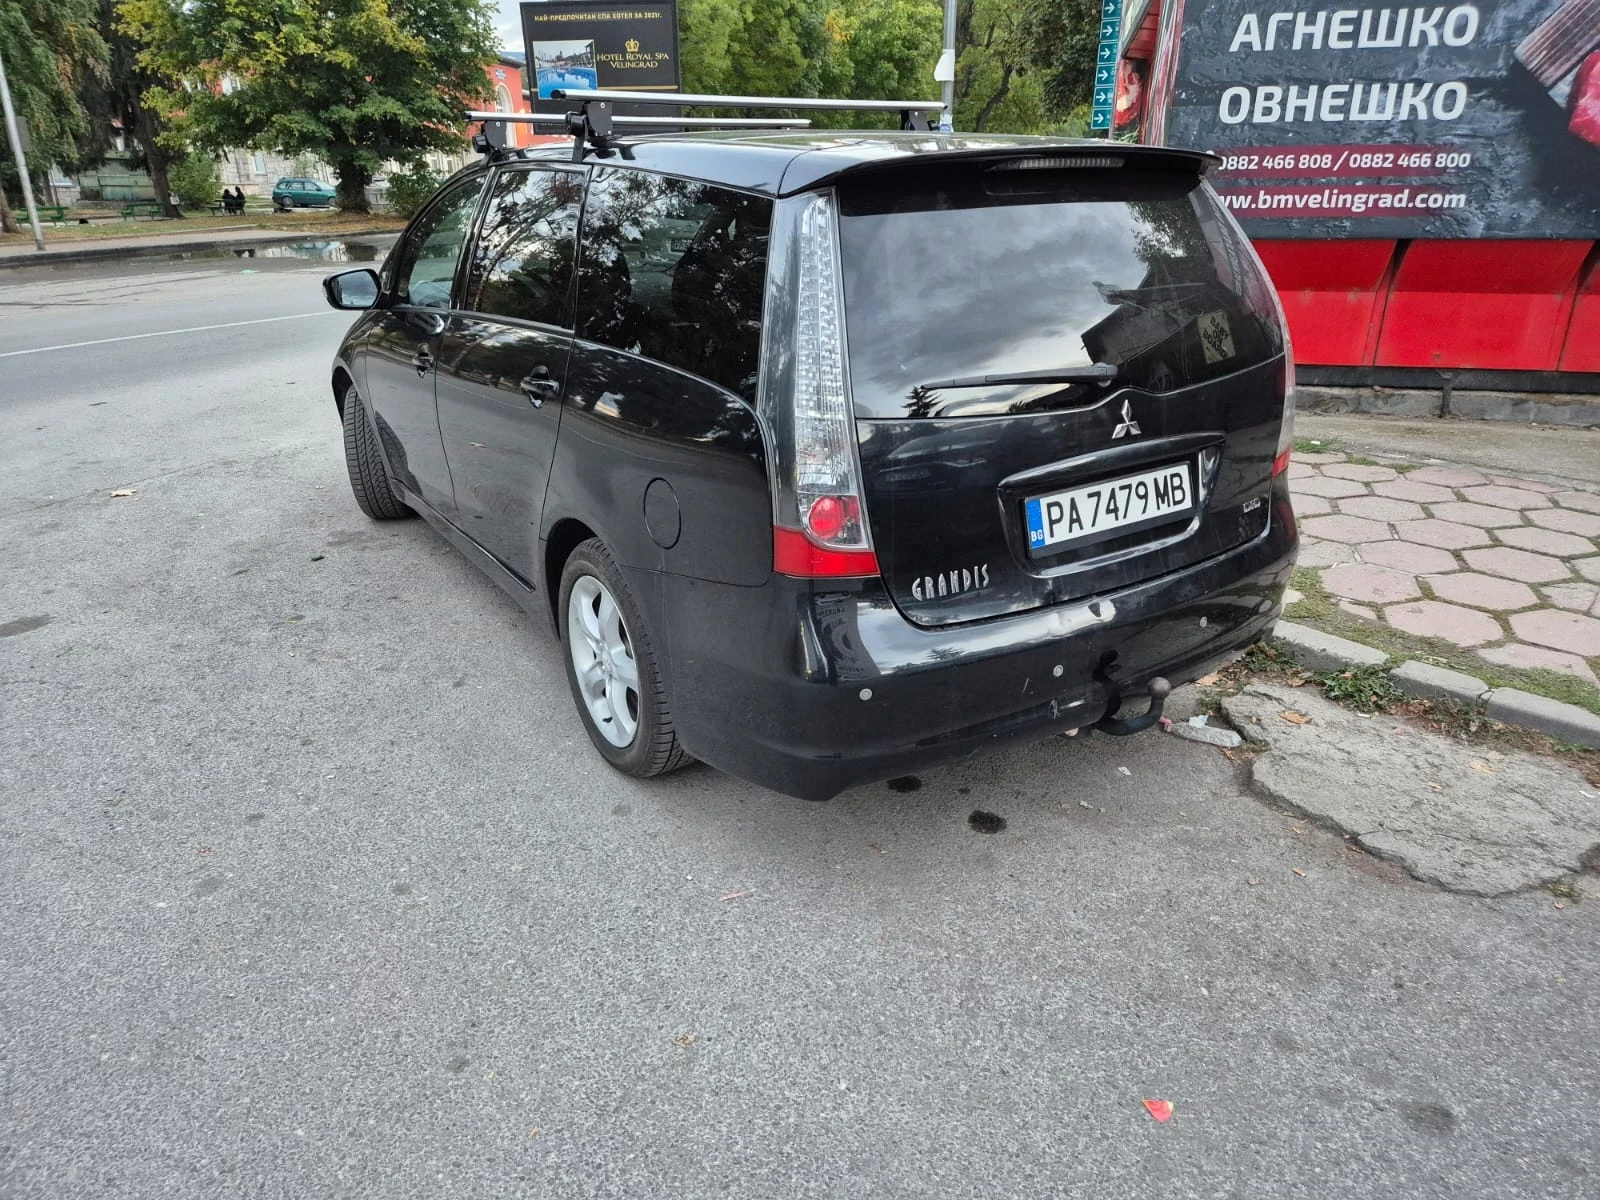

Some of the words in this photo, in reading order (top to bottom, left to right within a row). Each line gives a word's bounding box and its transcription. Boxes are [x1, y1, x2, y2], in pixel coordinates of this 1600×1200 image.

[1229, 6, 1479, 52] АГНЕШКО
[596, 53, 625, 62] HOTEL
[626, 53, 653, 61] ROYAL
[655, 52, 670, 61] SPA
[610, 60, 658, 69] VELINGRAD
[1219, 82, 1467, 124] ОВНЕШКО
[1261, 155, 1295, 170] 466
[1397, 153, 1432, 168] 466
[1434, 153, 1471, 168] 800
[1030, 530, 1044, 542] BG
[911, 563, 990, 602] GRANDIS
